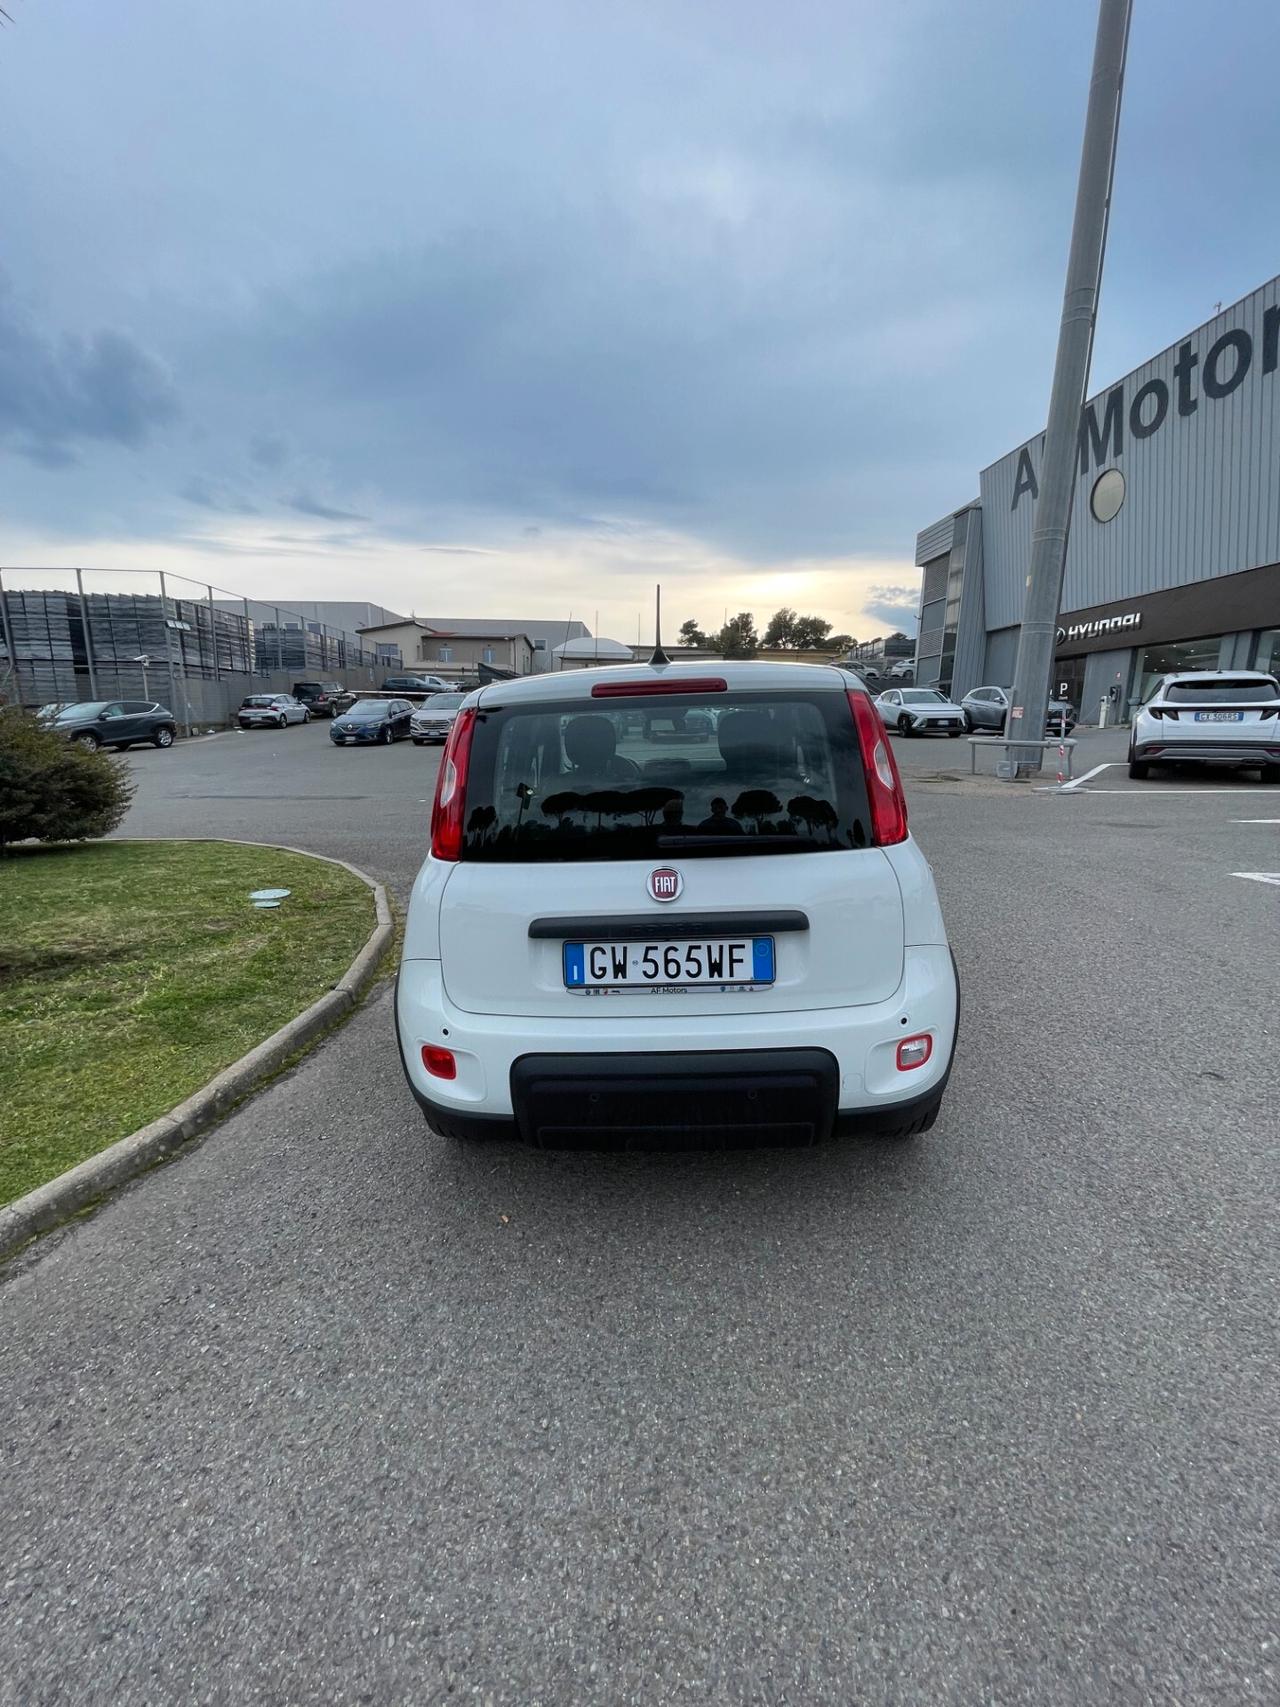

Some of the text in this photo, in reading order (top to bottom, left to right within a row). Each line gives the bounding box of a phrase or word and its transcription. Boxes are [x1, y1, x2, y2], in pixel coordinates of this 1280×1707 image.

[1011, 434, 1046, 512] A
[1068, 612, 1142, 641] HYUNDAI
[1060, 682, 1068, 695] P
[654, 876, 676, 893] FIAT
[589, 944, 746, 980] GW 565WF
[662, 986, 688, 994] Motors
